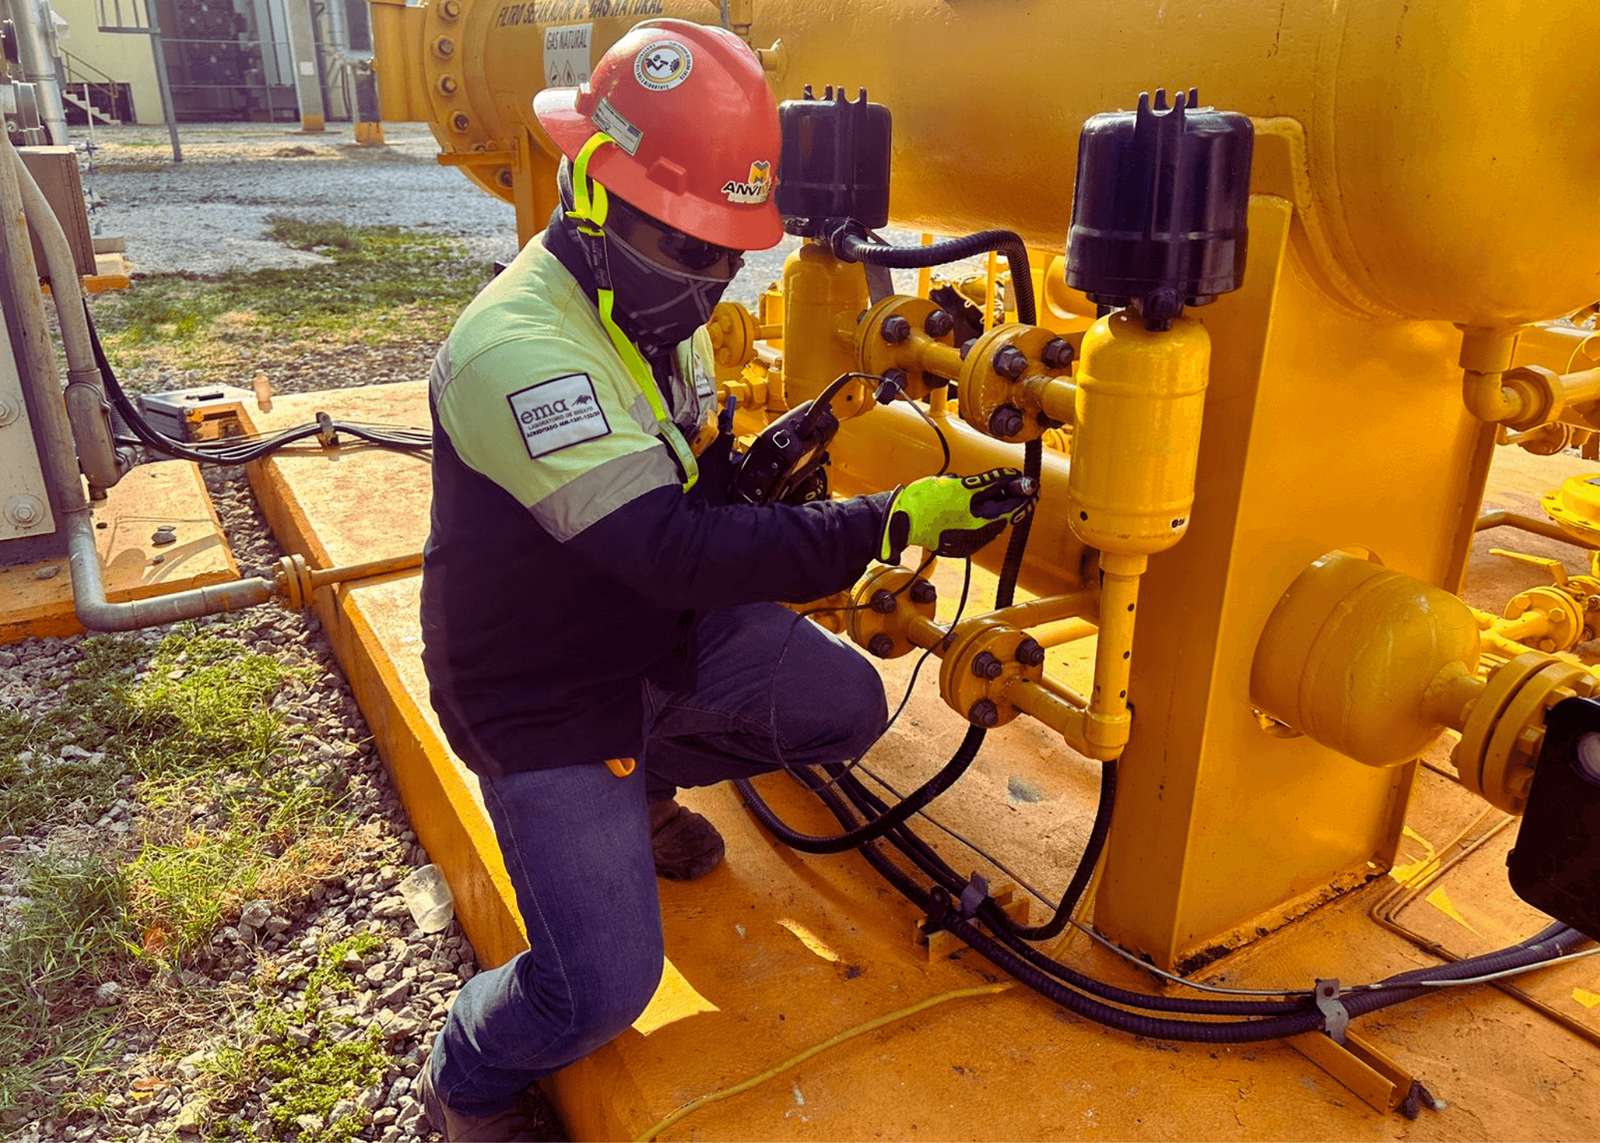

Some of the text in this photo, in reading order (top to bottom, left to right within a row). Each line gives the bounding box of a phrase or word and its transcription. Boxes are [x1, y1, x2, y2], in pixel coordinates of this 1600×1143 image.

[546, 29, 588, 50] GAS NATURAL
[520, 399, 569, 424] ema
